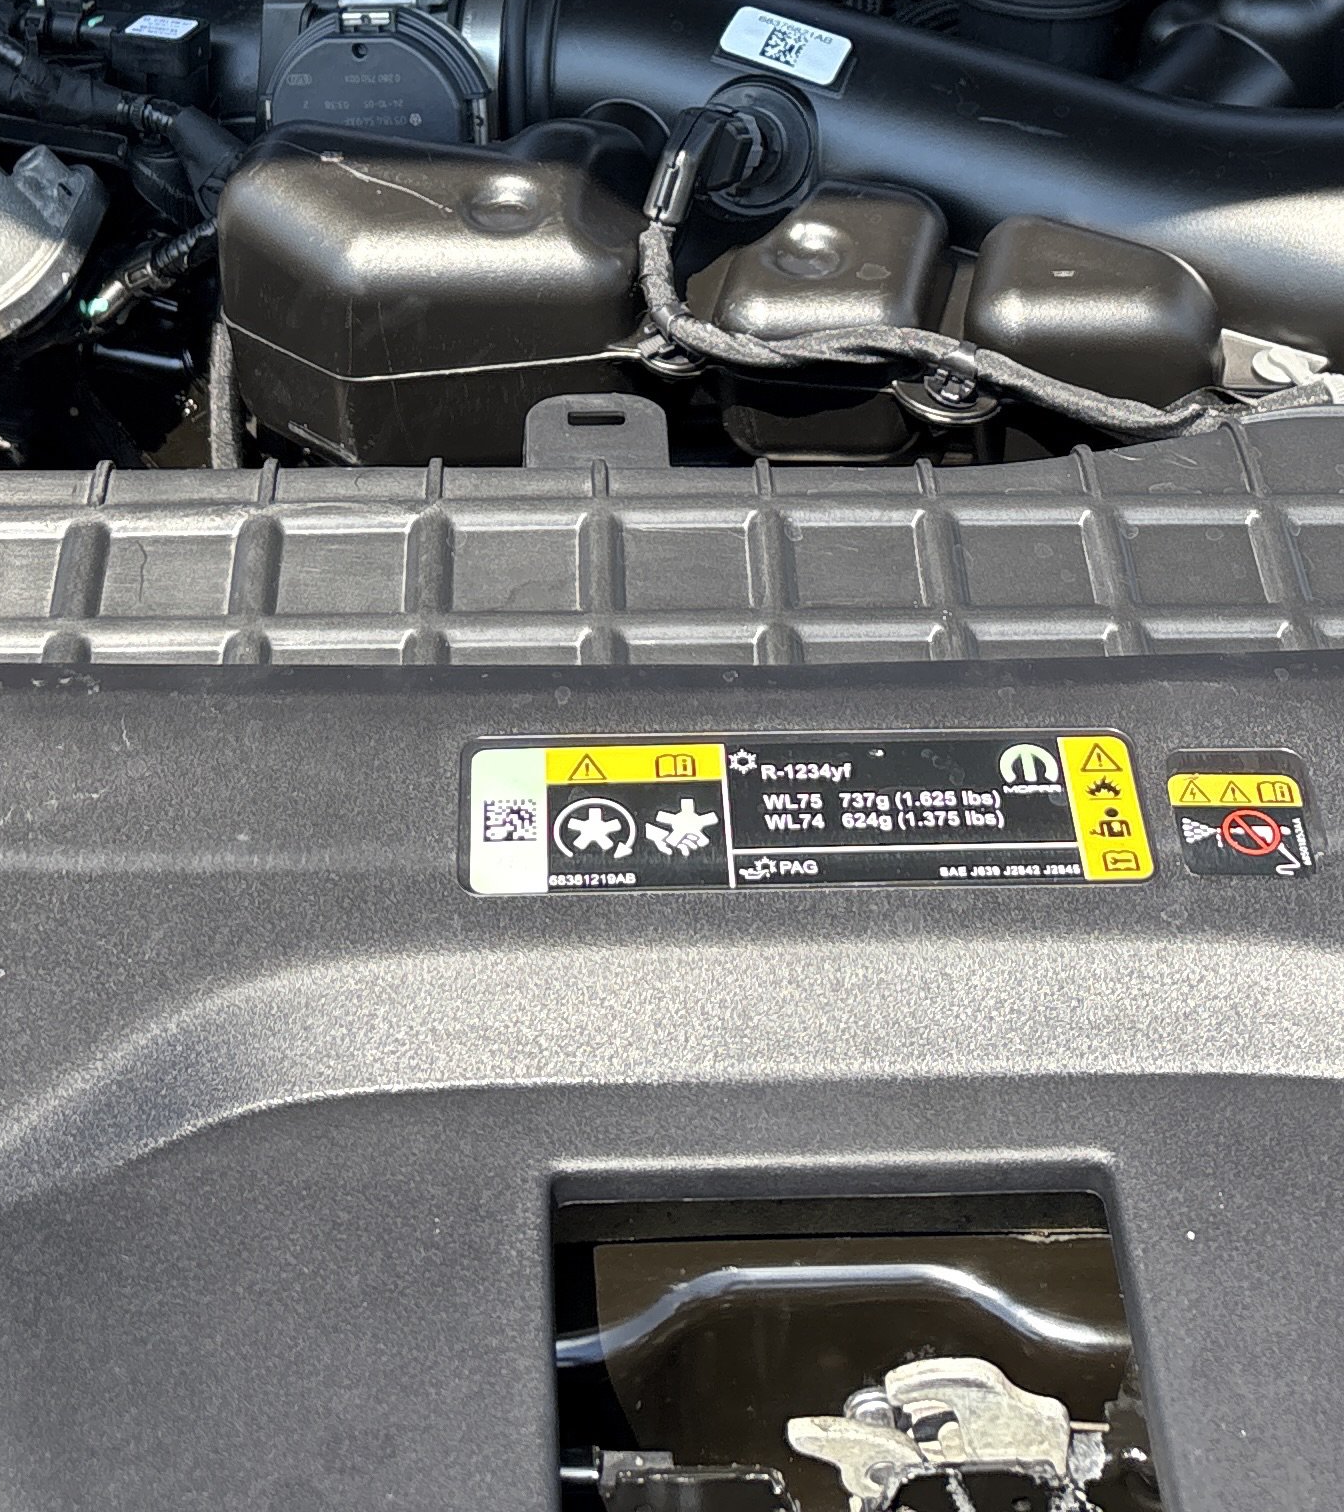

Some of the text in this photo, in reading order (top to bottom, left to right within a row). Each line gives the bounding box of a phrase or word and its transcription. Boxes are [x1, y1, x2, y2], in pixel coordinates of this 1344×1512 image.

[761, 762, 852, 782] R-1234yf
[1002, 784, 1062, 794] MOPAR
[762, 789, 1001, 811] WL75 737g (1.625 lbs)
[764, 809, 1005, 831] WL74 624g (1.375 lbs)
[779, 859, 819, 875] PAG
[939, 865, 967, 877] SAE
